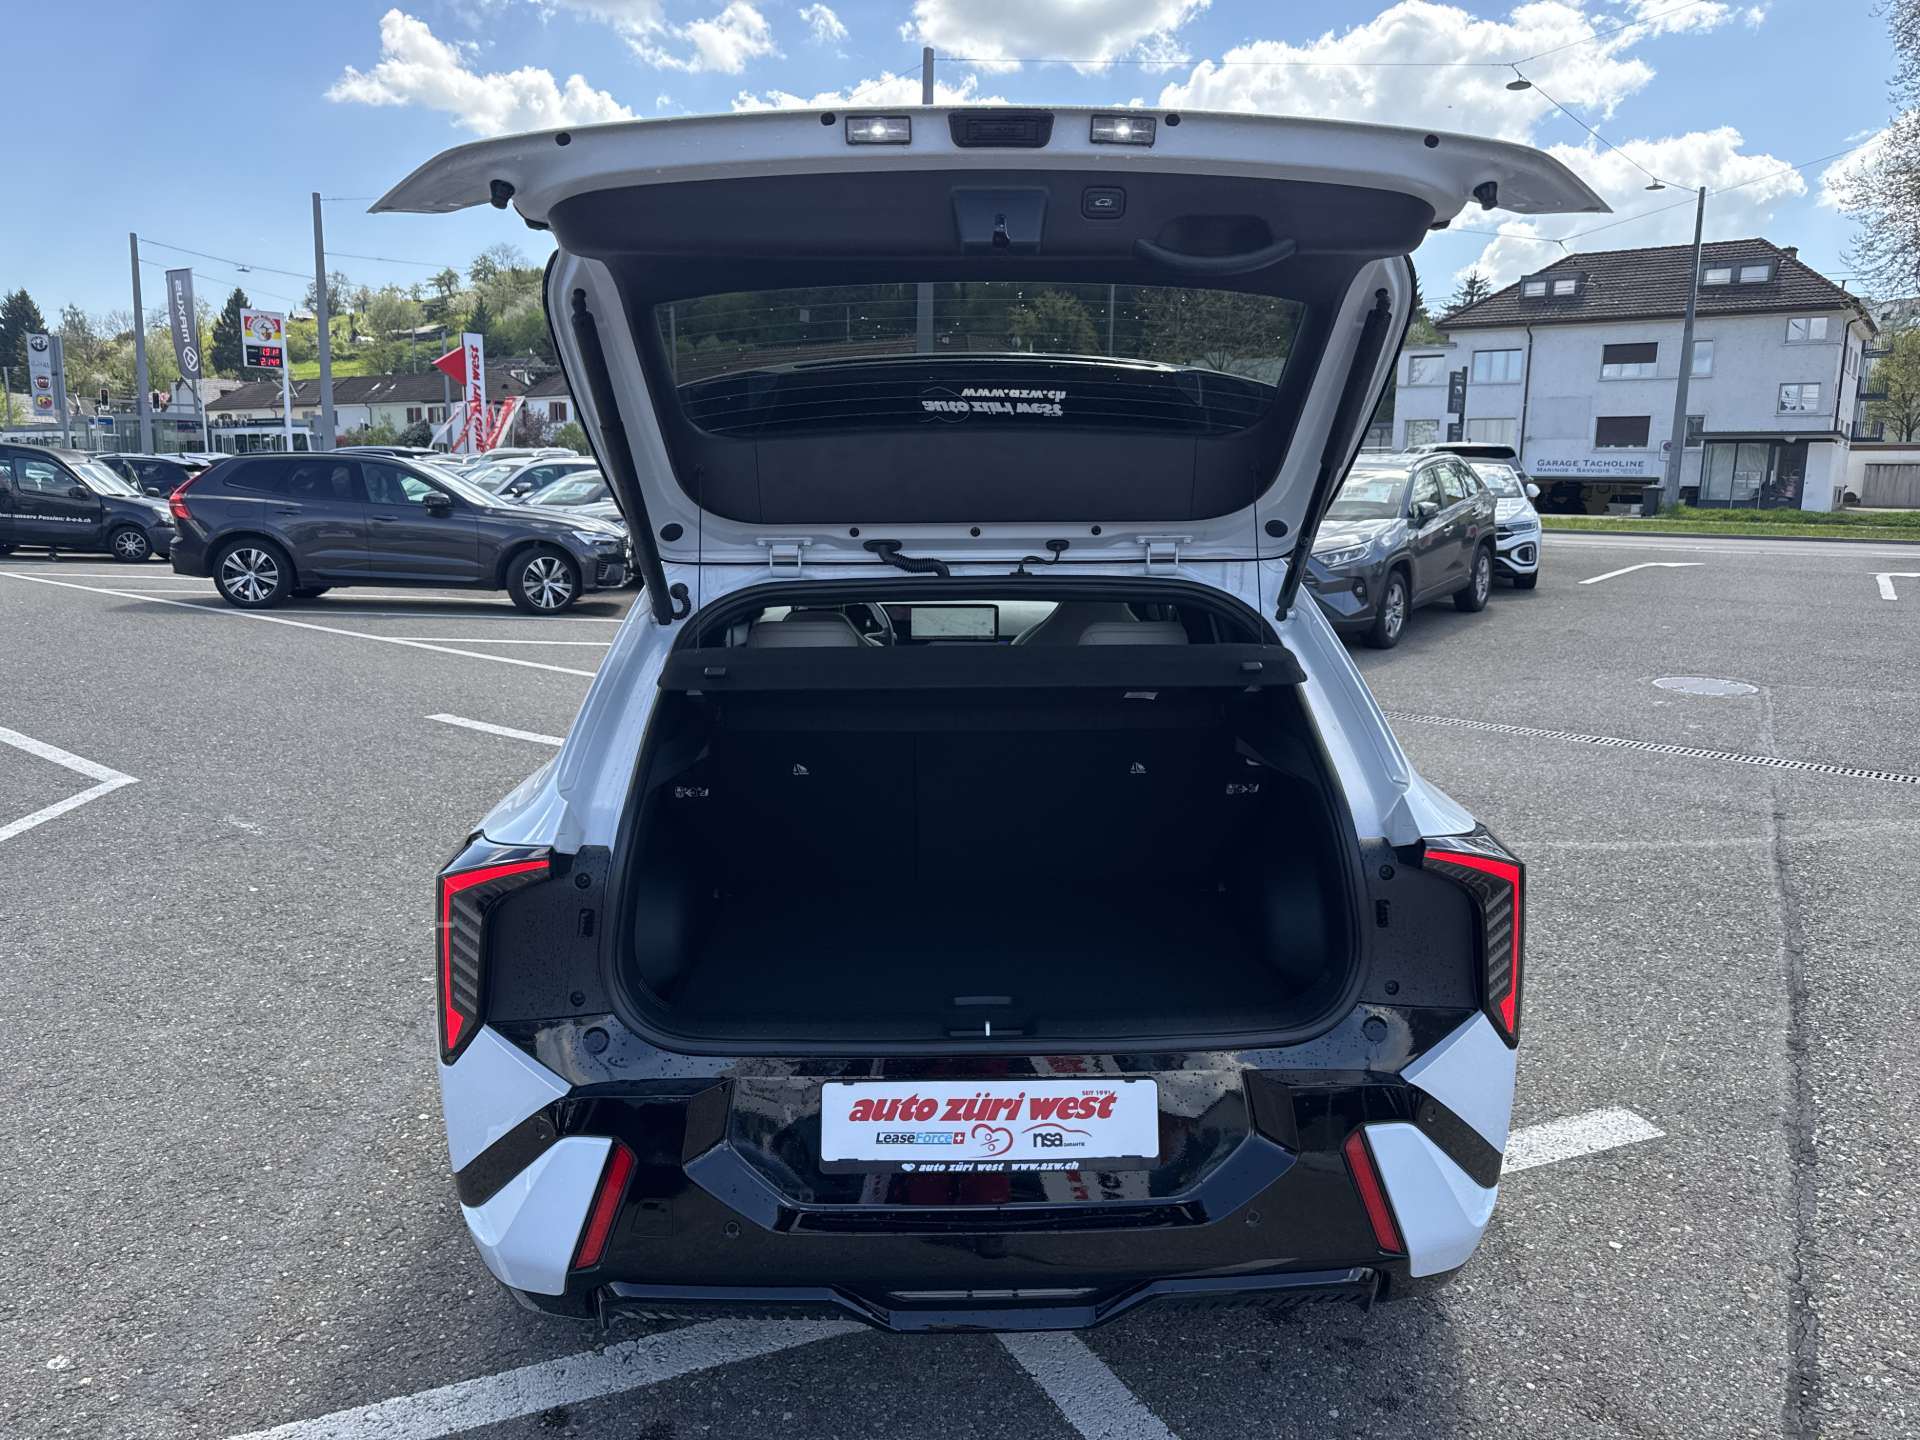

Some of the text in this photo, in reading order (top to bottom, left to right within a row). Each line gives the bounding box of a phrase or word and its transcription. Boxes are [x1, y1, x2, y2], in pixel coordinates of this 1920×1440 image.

[469, 344, 480, 381] west
[848, 1091, 1118, 1122] auto züri west
[875, 1132, 953, 1145] LeaseForce
[1033, 1132, 1063, 1148] nsa
[918, 1161, 1080, 1172] auto züri west www.azw.ch
